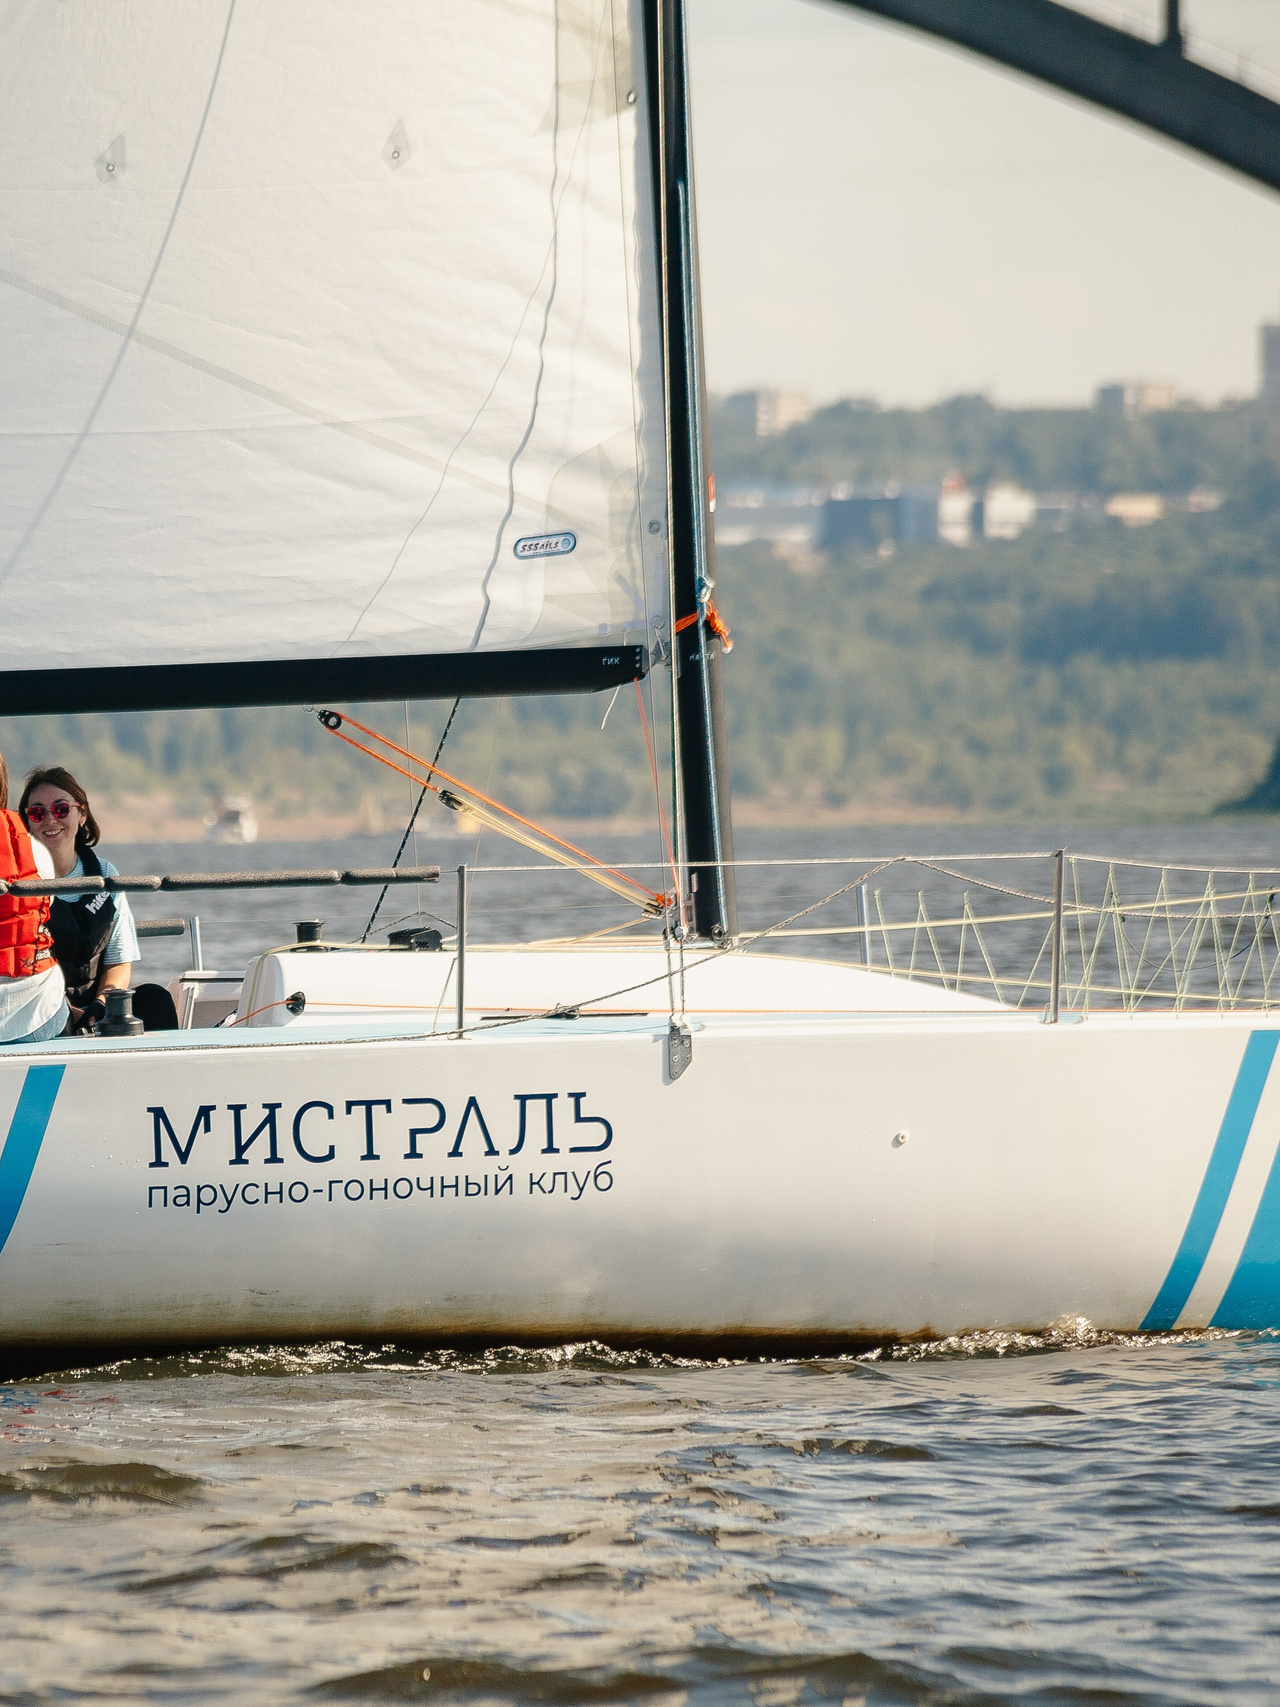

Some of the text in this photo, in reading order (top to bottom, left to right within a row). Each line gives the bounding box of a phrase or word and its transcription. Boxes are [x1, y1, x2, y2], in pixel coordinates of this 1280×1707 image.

[602, 657, 620, 665] ГИК
[689, 653, 715, 662] МАТА
[146, 1091, 613, 1169] МИСТРАЛЬ
[147, 1160, 614, 1214] парусно-гоночный клуб
